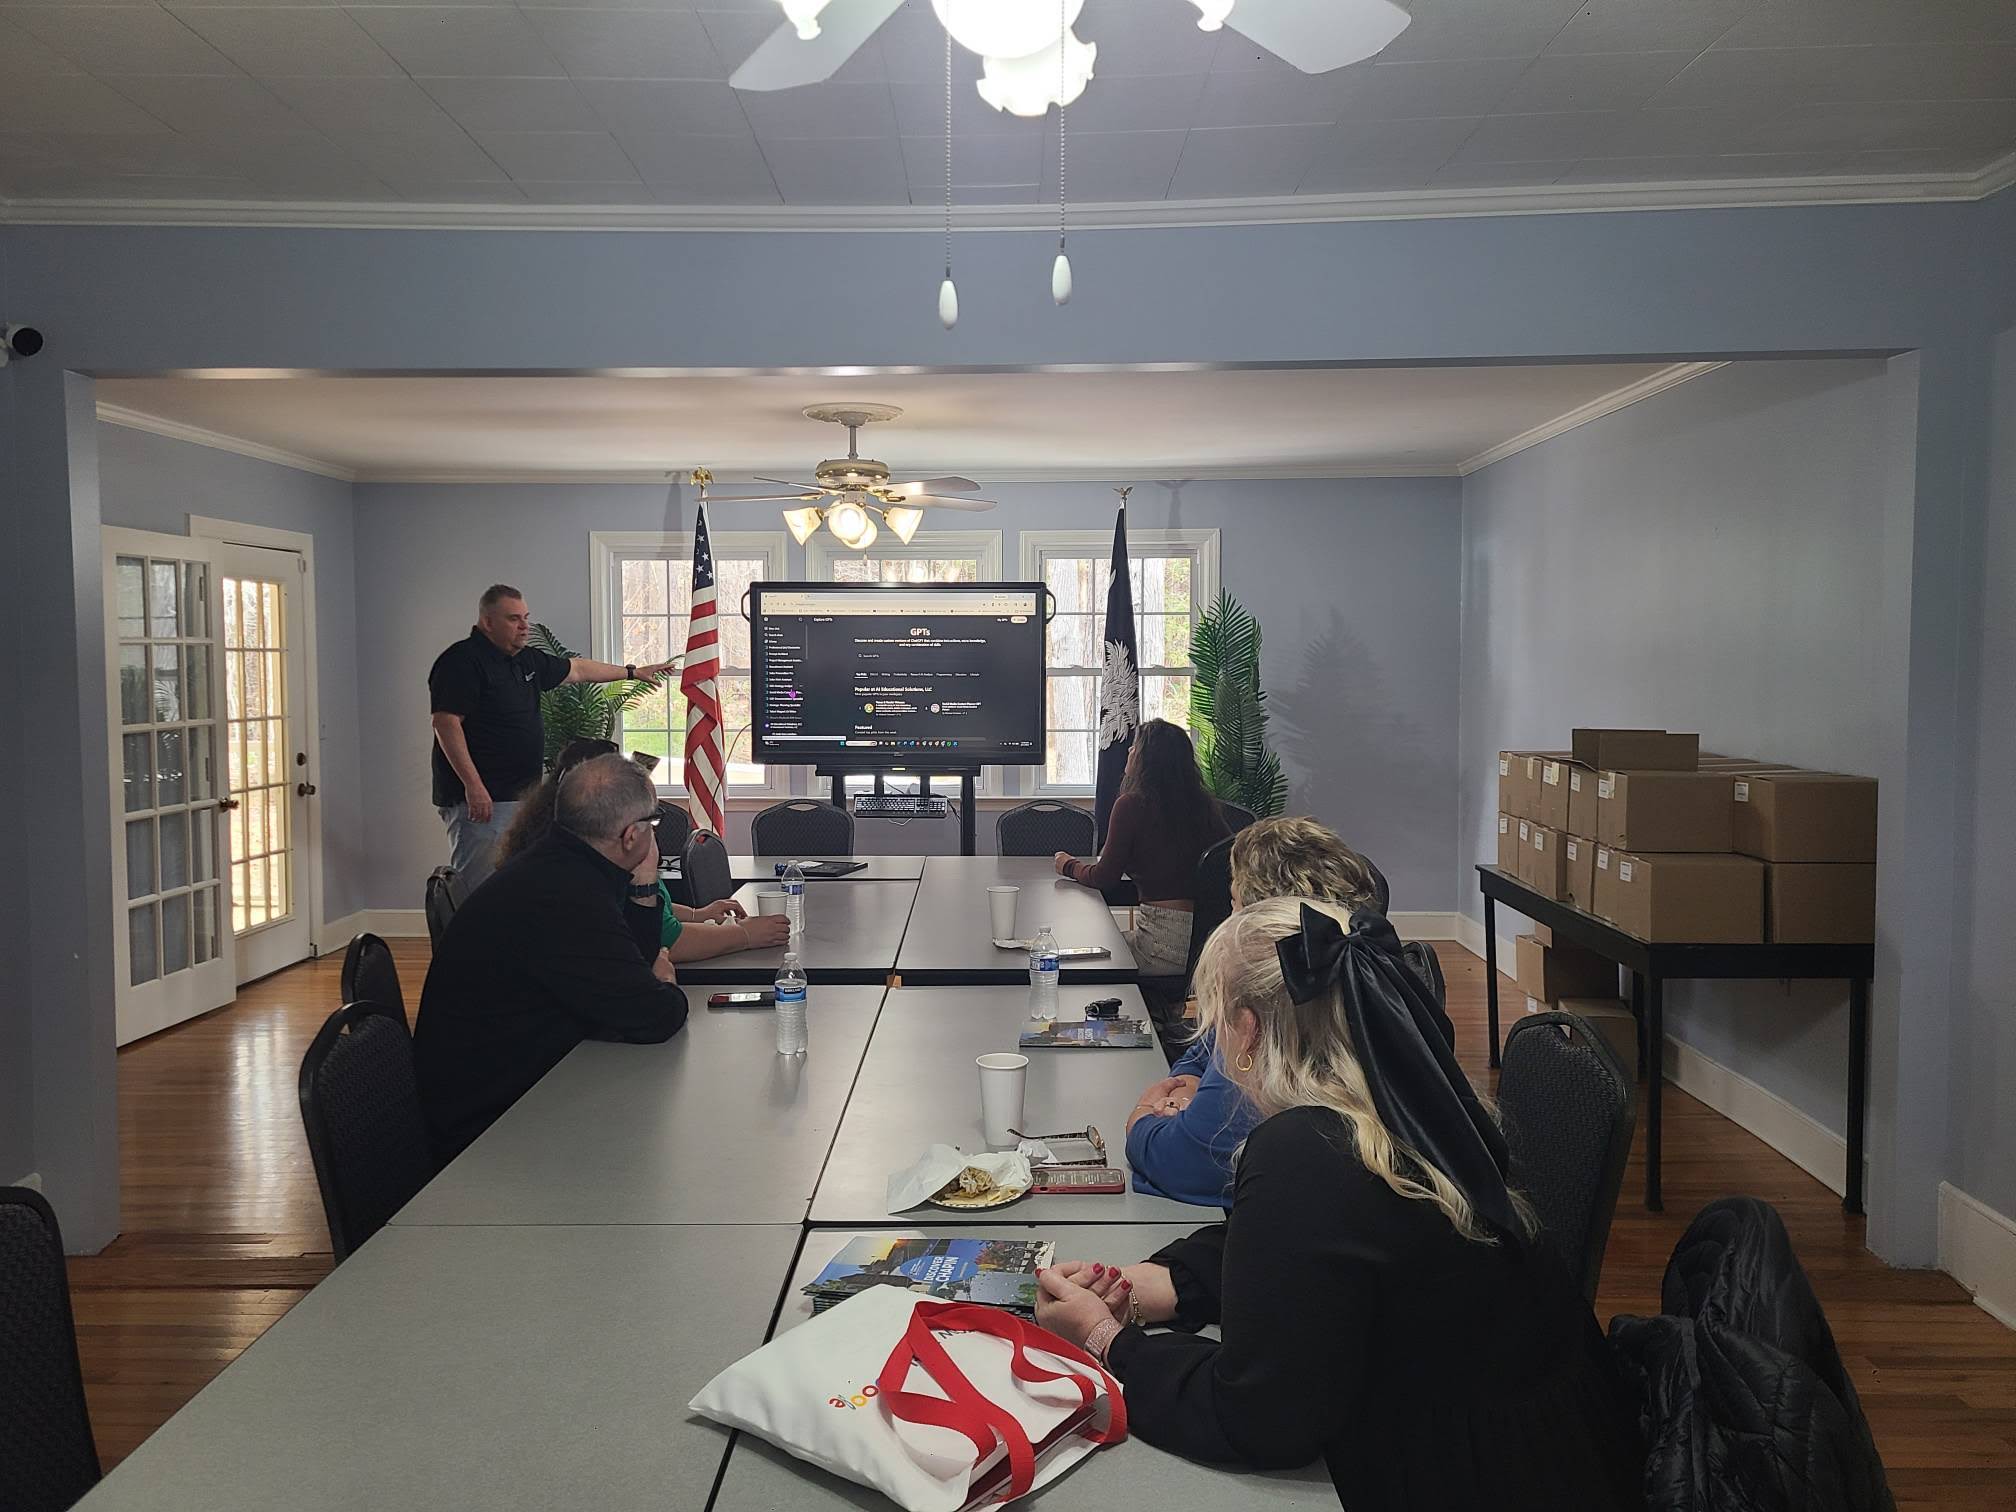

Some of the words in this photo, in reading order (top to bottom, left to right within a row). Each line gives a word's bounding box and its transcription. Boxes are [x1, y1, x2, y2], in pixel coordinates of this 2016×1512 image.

[910, 628, 931, 636] GPTs
[923, 1256, 945, 1281] DISCOVER
[935, 1256, 959, 1282] CHAPIN
